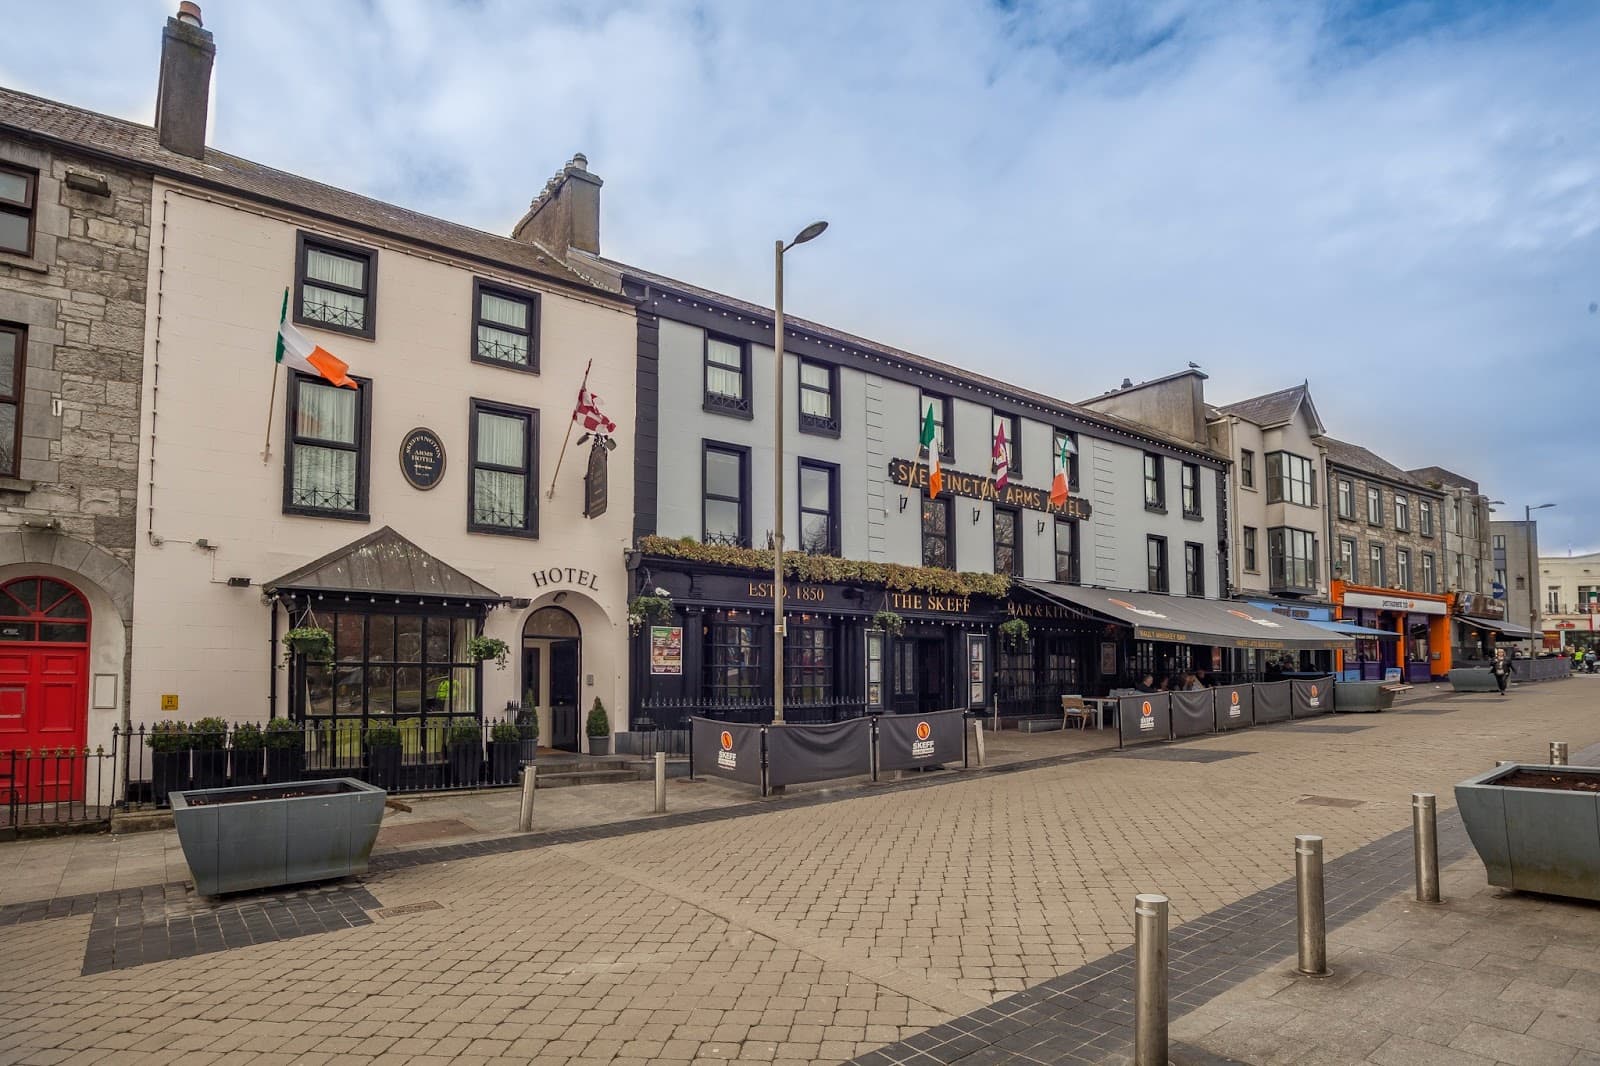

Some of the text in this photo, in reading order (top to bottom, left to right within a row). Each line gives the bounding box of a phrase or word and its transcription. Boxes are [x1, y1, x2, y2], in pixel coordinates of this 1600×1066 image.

[898, 464, 1084, 515] SKEFINGTON ARMS HTEL
[532, 567, 599, 592] HOTEL
[796, 586, 825, 601] 1850
[891, 593, 970, 613] THE SKEFF
[1007, 601, 1032, 616] BAR
[1034, 604, 1042, 617] &
[912, 741, 934, 750] SKEFF
